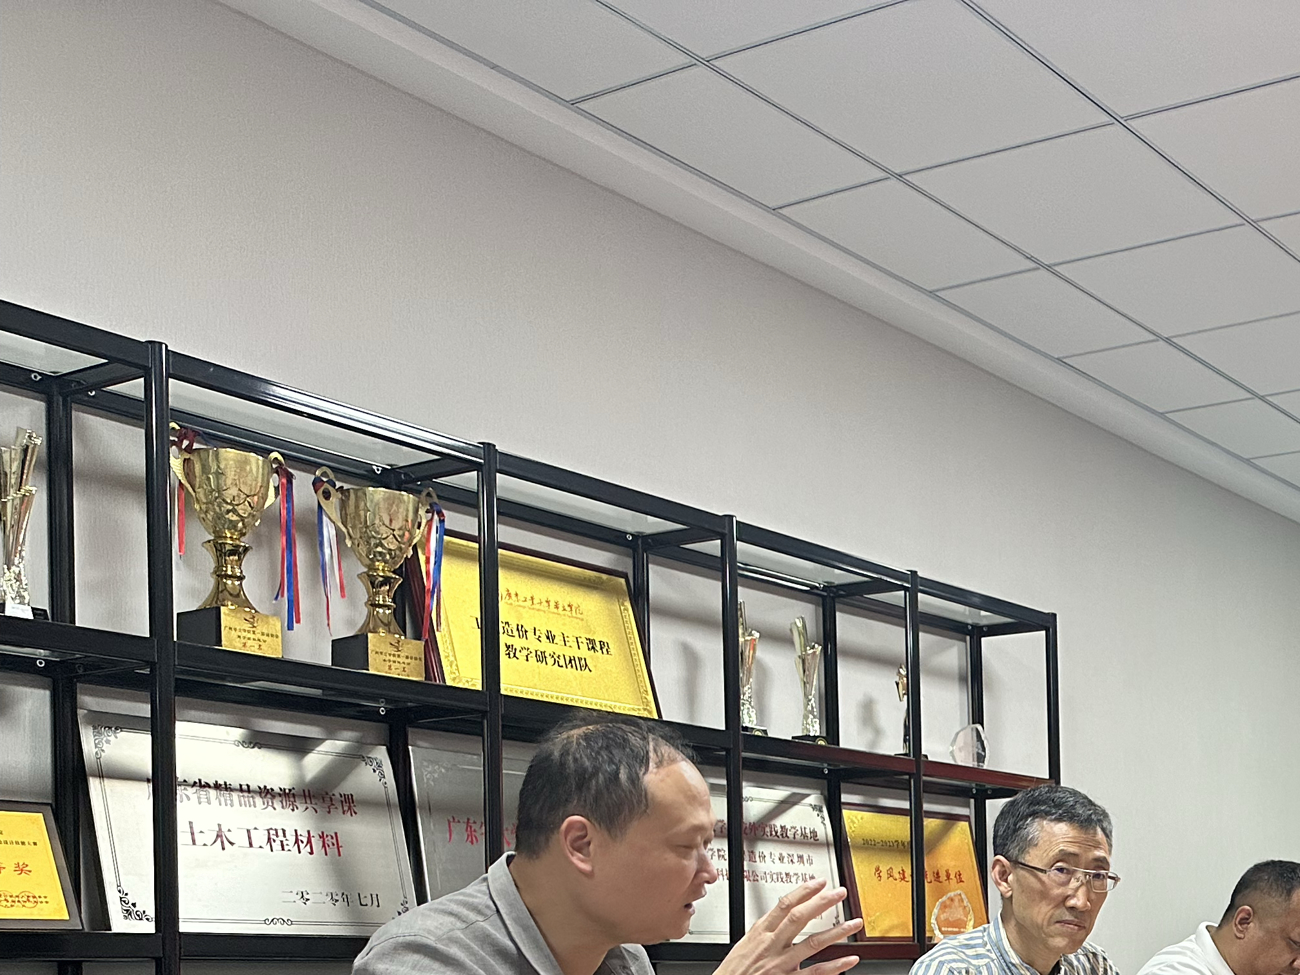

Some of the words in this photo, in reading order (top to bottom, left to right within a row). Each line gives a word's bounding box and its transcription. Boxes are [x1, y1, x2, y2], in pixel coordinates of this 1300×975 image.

[470, 615, 613, 656] 工造价专业主干课程
[504, 642, 592, 673] 教学研究团队
[146, 777, 358, 818] 东省精品资源共享课
[180, 820, 344, 858] 土木工程材料
[282, 889, 381, 908] 二零二零年七月
